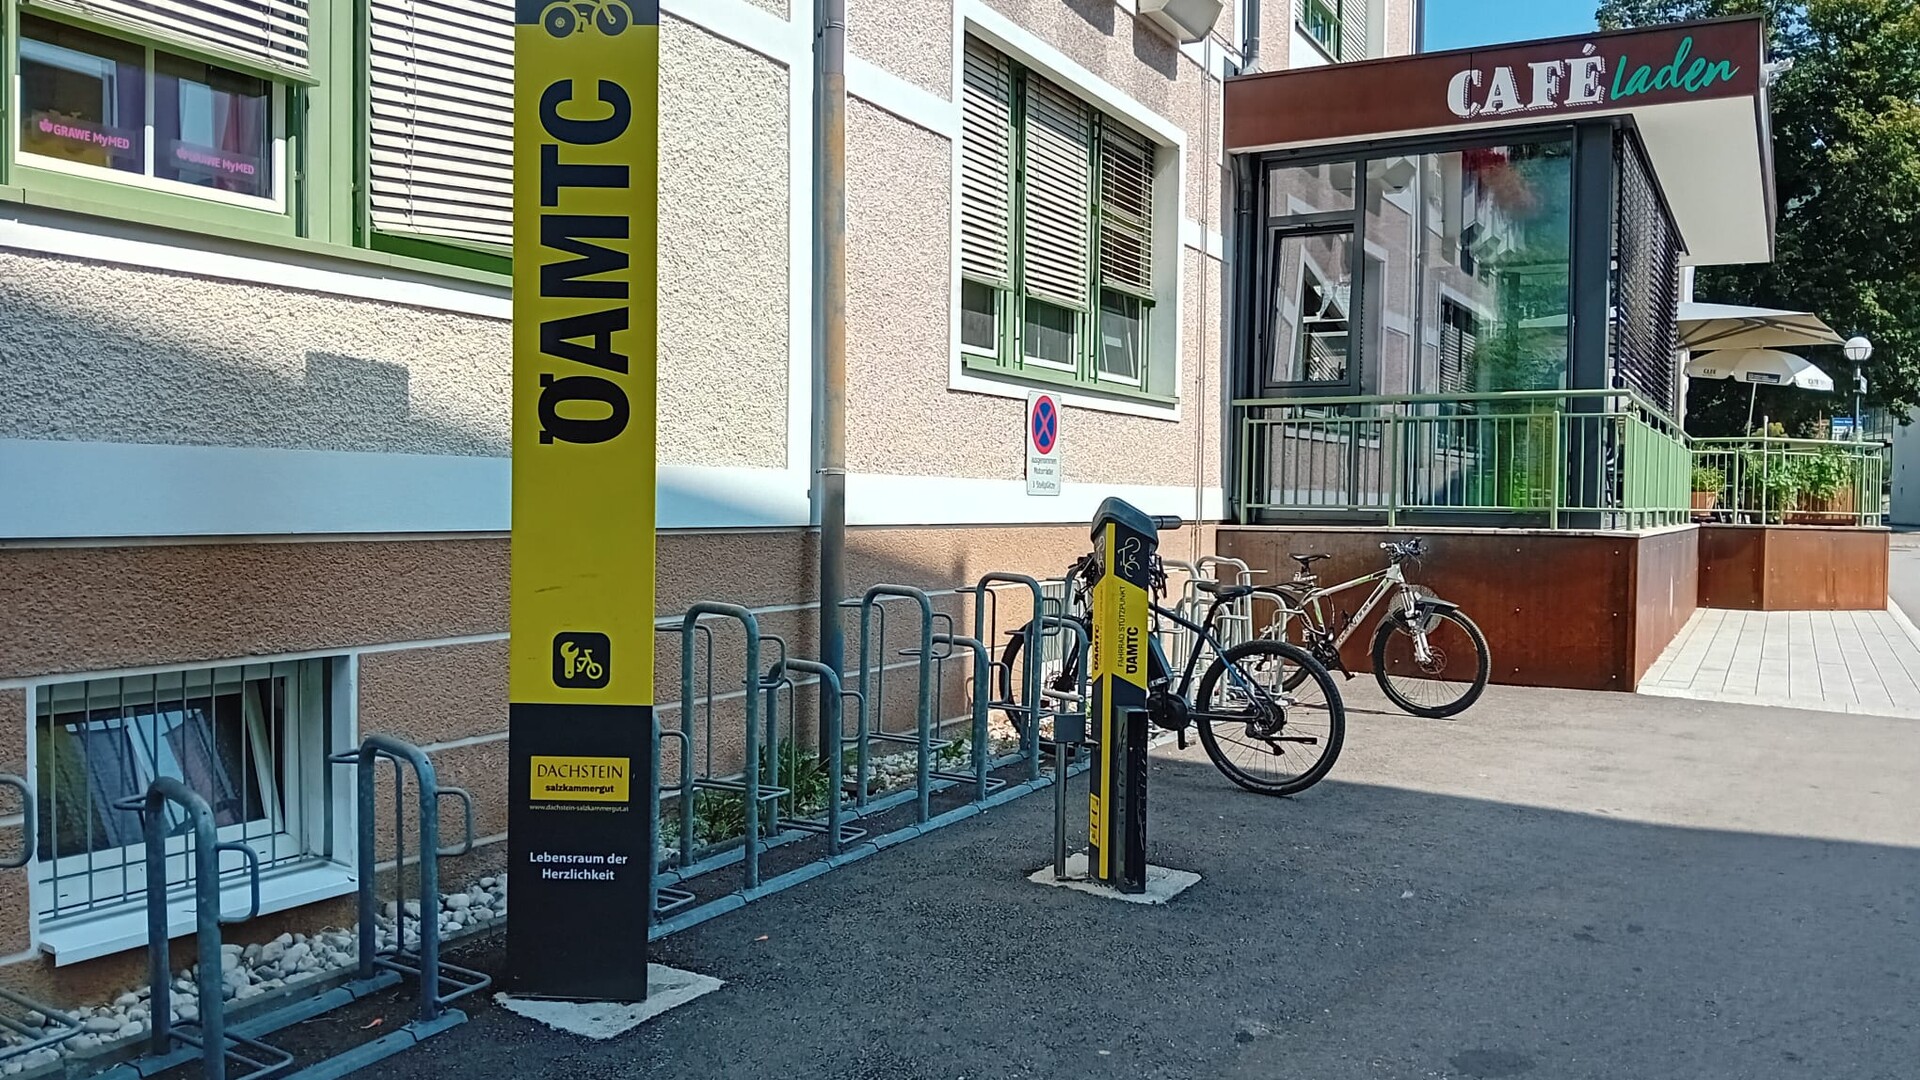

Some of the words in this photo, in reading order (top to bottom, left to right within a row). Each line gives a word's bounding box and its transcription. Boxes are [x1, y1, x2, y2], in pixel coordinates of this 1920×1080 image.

[1447, 43, 1606, 119] CAFÉ
[53, 124, 91, 142] GRAWE
[92, 132, 130, 149] MyMED
[222, 158, 255, 175] MyMED
[538, 79, 632, 444] ÖAMTC
[1126, 626, 1139, 675] ÖAMTC
[537, 763, 623, 779] DACHSTEIN
[545, 783, 615, 794] salzkammergut
[529, 804, 629, 813] www.dachstein-salzkammergut.at
[530, 851, 604, 864] Lebensraum
[606, 853, 628, 864] der
[542, 868, 615, 881] Herzlichkeit
